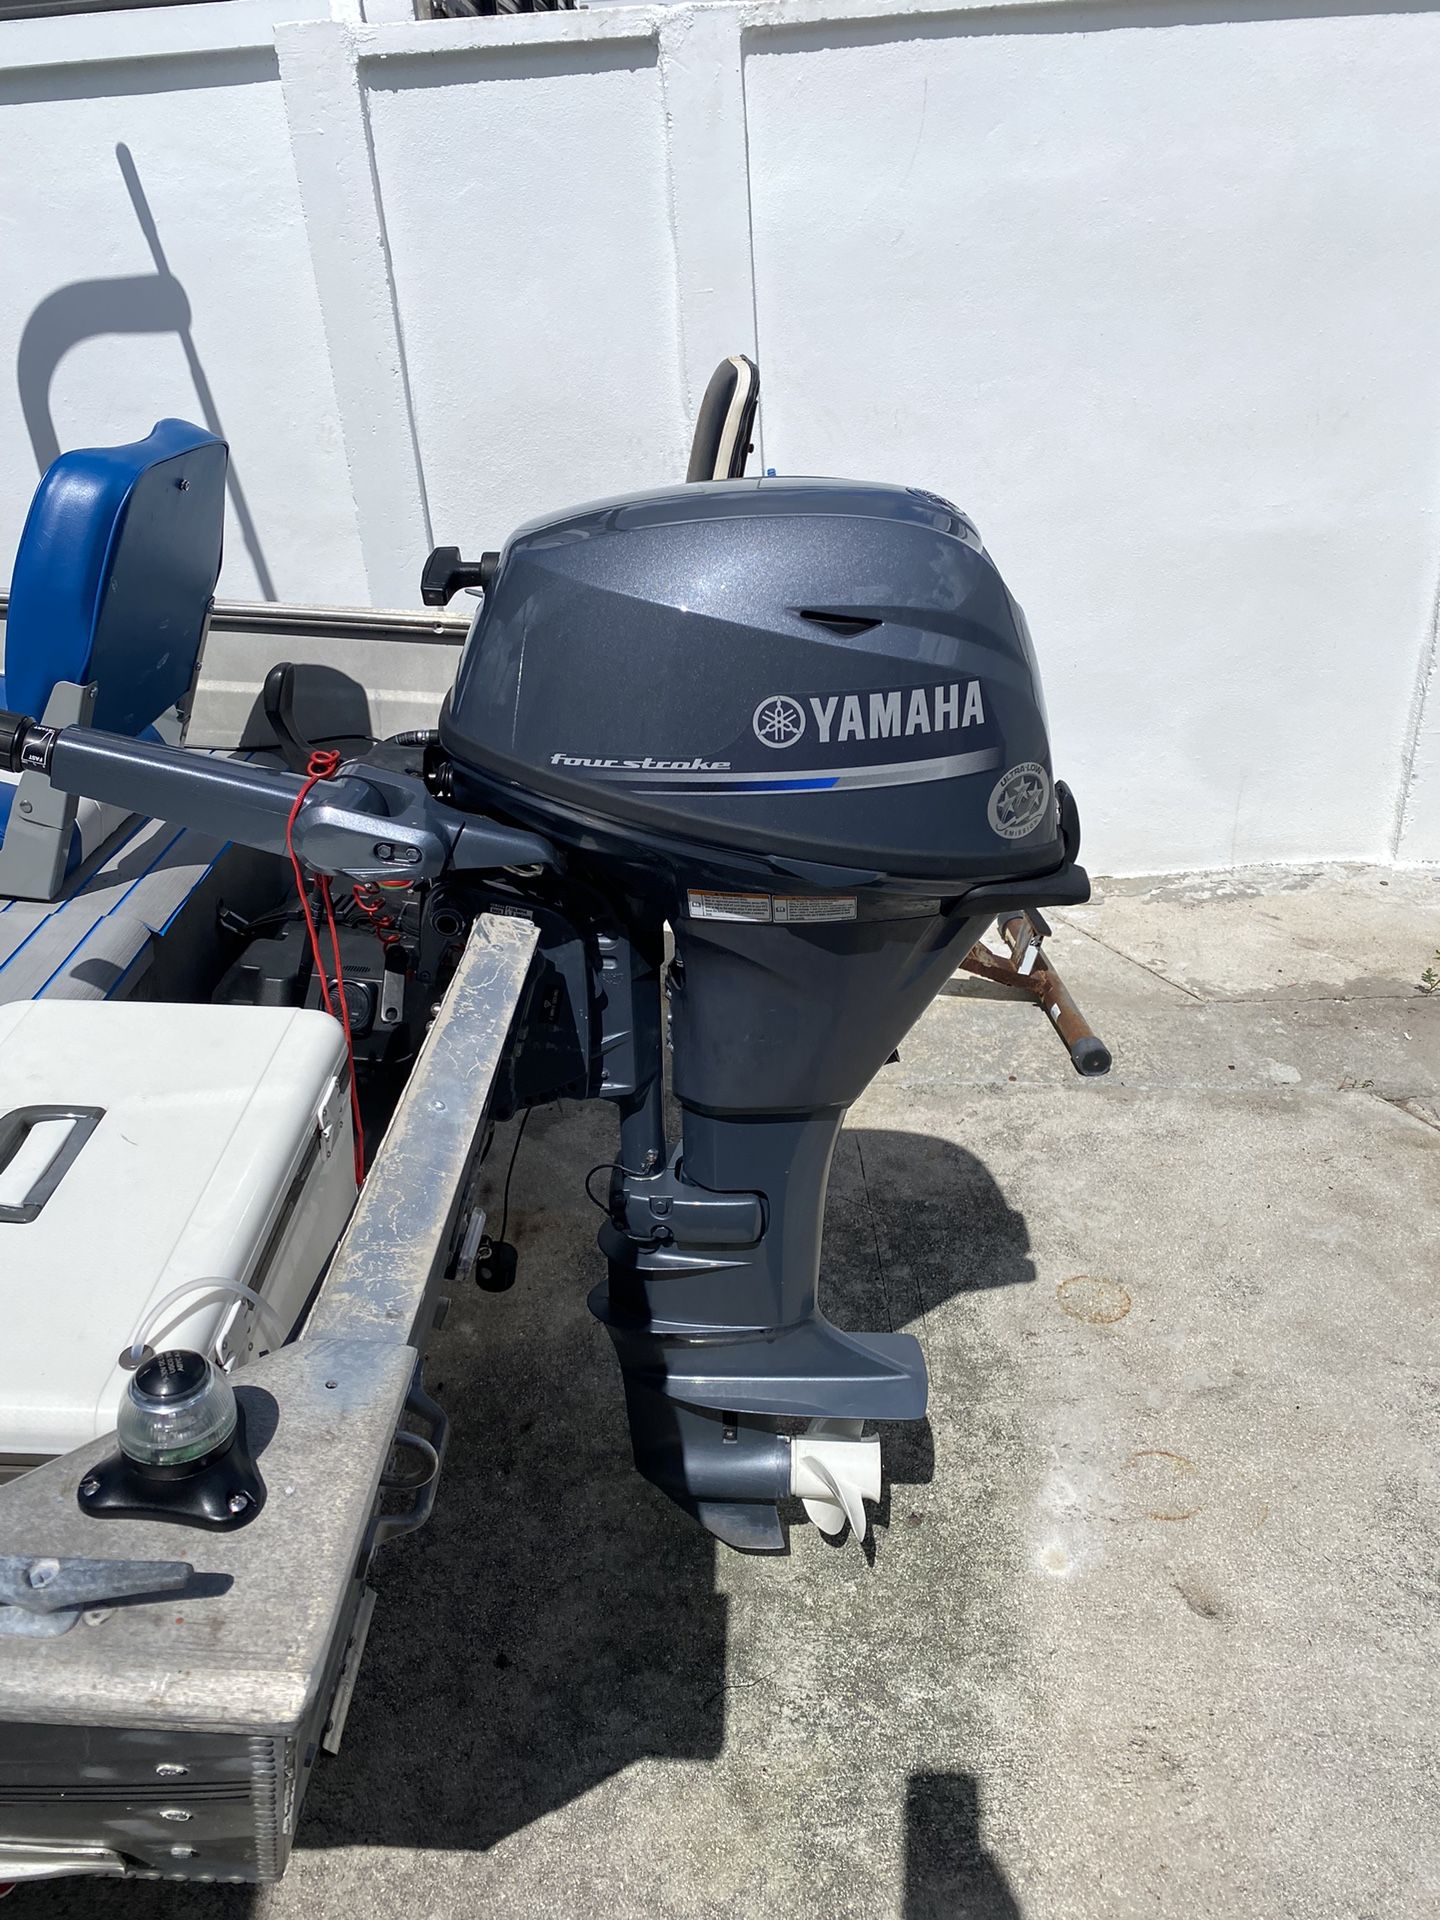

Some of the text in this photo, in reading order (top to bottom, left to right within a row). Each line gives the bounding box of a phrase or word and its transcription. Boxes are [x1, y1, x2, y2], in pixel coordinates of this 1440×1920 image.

[809, 680, 985, 743] YAMAHA
[28, 754, 43, 762] FAST
[551, 753, 731, 770] four stroke
[1000, 764, 1043, 787] ULTRA-LOW
